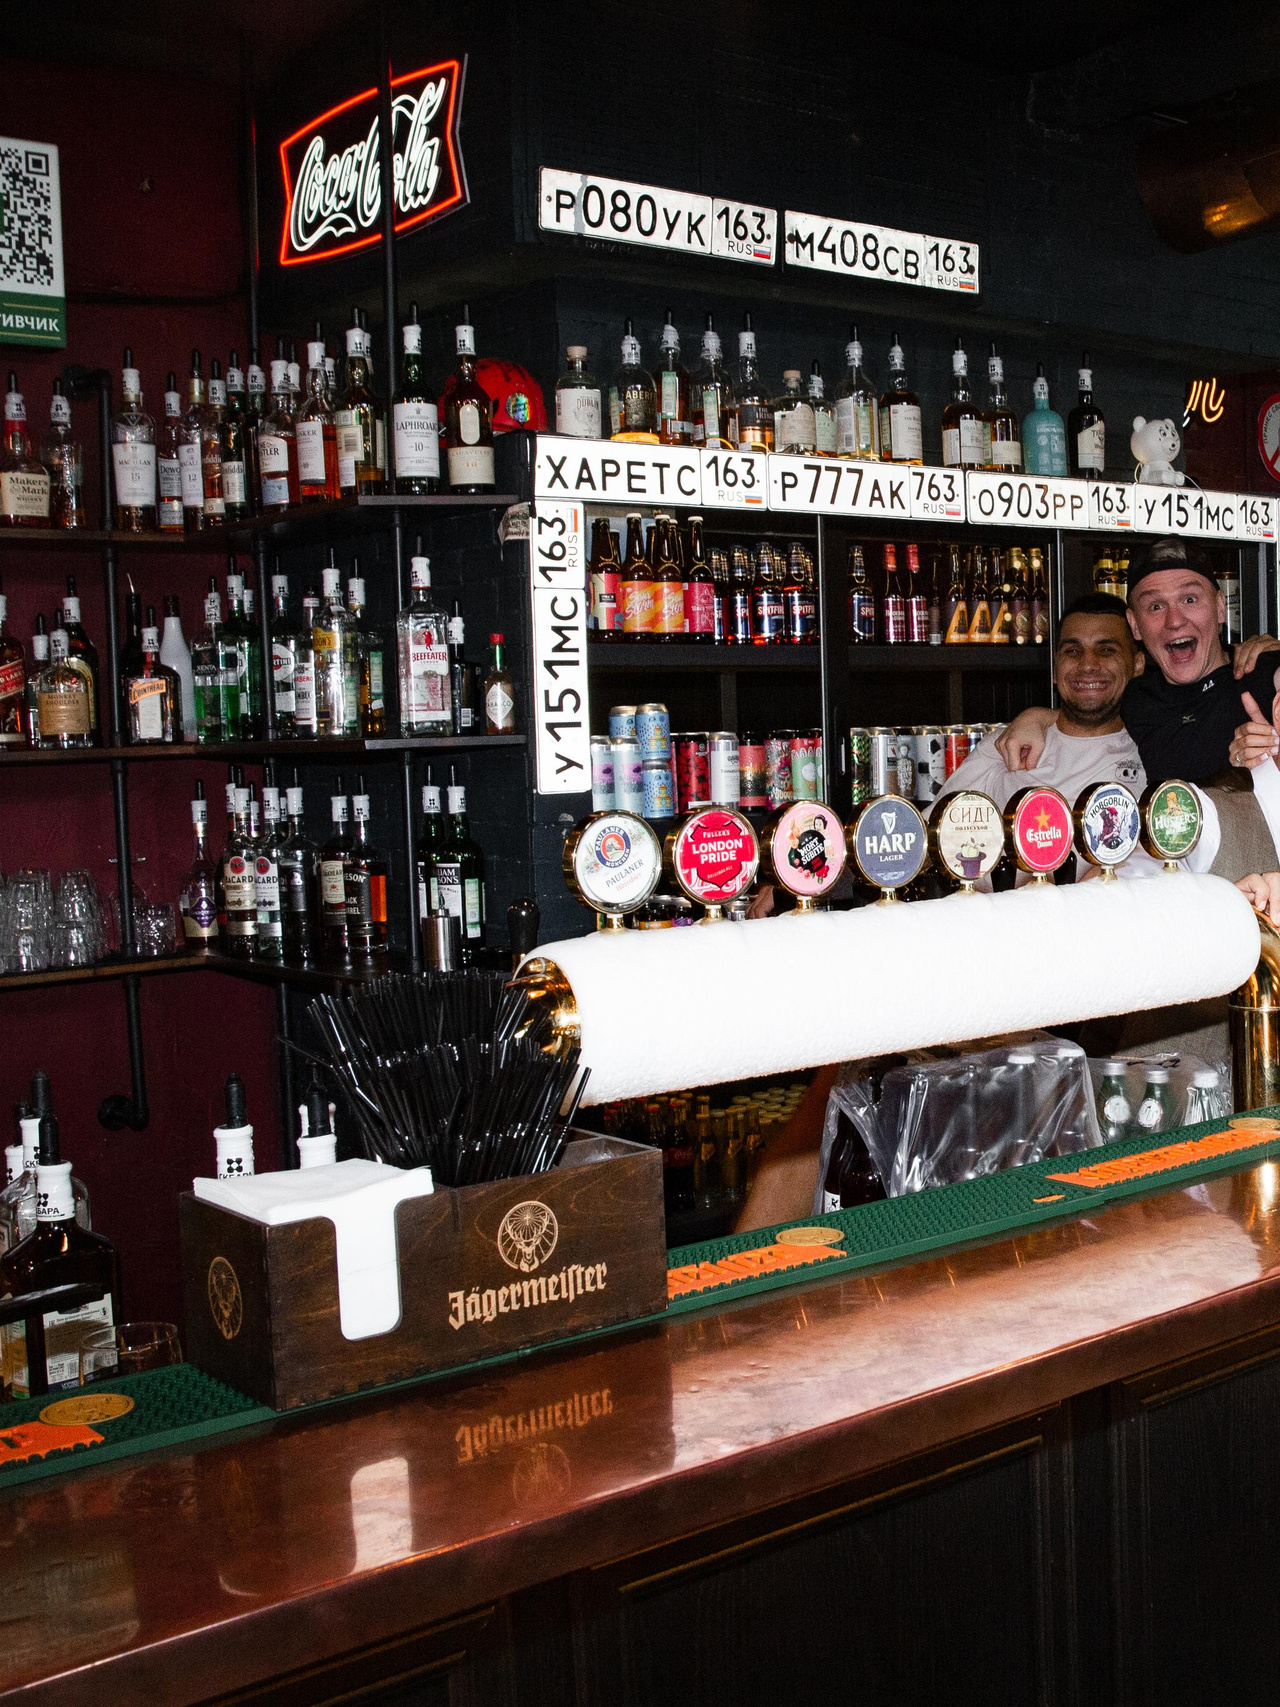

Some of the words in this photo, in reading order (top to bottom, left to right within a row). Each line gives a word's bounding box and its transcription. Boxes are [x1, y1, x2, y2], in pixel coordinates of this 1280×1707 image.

[716, 205, 766, 244] 163
[727, 240, 753, 256] RUS
[927, 243, 971, 275] 163
[937, 275, 959, 287] RUS
[0, 313, 61, 333] ИВЧИК
[299, 429, 317, 437] SKER
[259, 446, 280, 458] STLER
[414, 441, 424, 452] 10
[131, 471, 141, 481] 15
[546, 453, 697, 496] ХАРЕТС
[705, 456, 755, 489] 163
[22, 486, 48, 496] Mark
[913, 471, 954, 502] 763
[718, 490, 744, 503] RUS
[1091, 486, 1126, 514] 163
[922, 502, 946, 515] RUS
[1239, 500, 1270, 526] 163
[1097, 514, 1117, 526] RUS
[1245, 526, 1262, 537] RUS
[538, 515, 567, 583] 163
[568, 534, 579, 568] RUS
[273, 658, 292, 667] RTINI
[412, 651, 447, 662] BEEFEATER
[1089, 796, 1130, 819] HOBGOBLIN
[949, 807, 995, 825] СИДР
[595, 826, 625, 851] PAULANER
[703, 829, 731, 838] FULLER'S
[1026, 827, 1062, 842] Estrella
[691, 838, 743, 855] LONDON
[865, 832, 916, 855] HARP
[700, 850, 737, 865] PRIDE
[880, 854, 904, 862] LAGER
[605, 859, 644, 888] PAULANER
